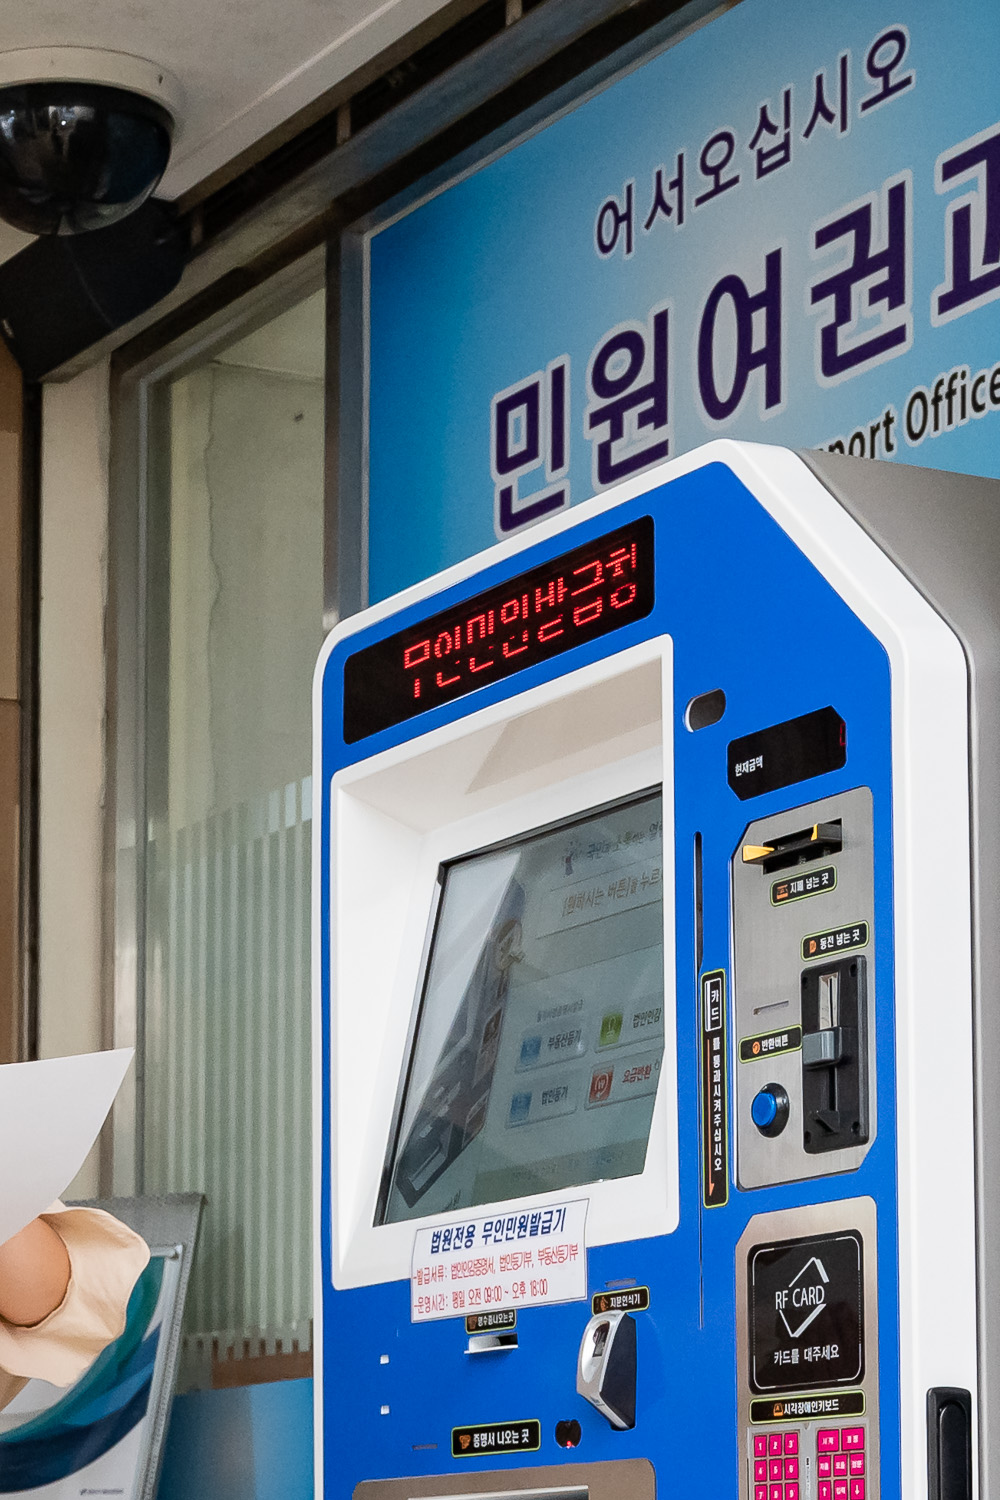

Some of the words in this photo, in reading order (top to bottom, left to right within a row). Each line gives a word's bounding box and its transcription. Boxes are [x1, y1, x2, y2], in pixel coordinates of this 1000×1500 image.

[597, 29, 913, 255] 어서오십시오
[906, 366, 1000, 441] Office
[735, 755, 763, 776] 현재금액
[790, 874, 804, 893] 지폐
[806, 874, 820, 890] 넣는
[821, 872, 829, 886] 곳
[819, 936, 834, 950] 동전
[836, 931, 850, 946] 넣는
[852, 928, 860, 941] 곳
[711, 988, 720, 1021] 카드
[762, 1034, 788, 1052] 반환버튼
[431, 1224, 476, 1254] 법원전용
[482, 1207, 567, 1245] 무인민원발급기
[538, 1243, 579, 1266] 부동산등기부
[452, 1289, 465, 1309] 평일
[468, 1288, 481, 1305] 오전
[484, 1285, 502, 1304] 09:00
[512, 1281, 527, 1299] 오후
[530, 1278, 548, 1296] 18:00
[610, 1293, 641, 1308] 지문인식기
[775, 1290, 789, 1310] RF
[793, 1285, 825, 1308] CARD
[774, 1348, 799, 1365] 카드를
[804, 1344, 839, 1362] 대주세요
[784, 1399, 839, 1415] 시각장애인키보드
[473, 1432, 495, 1448] 증명서
[497, 1430, 520, 1445] 나오는
[521, 1428, 529, 1443] 곳
